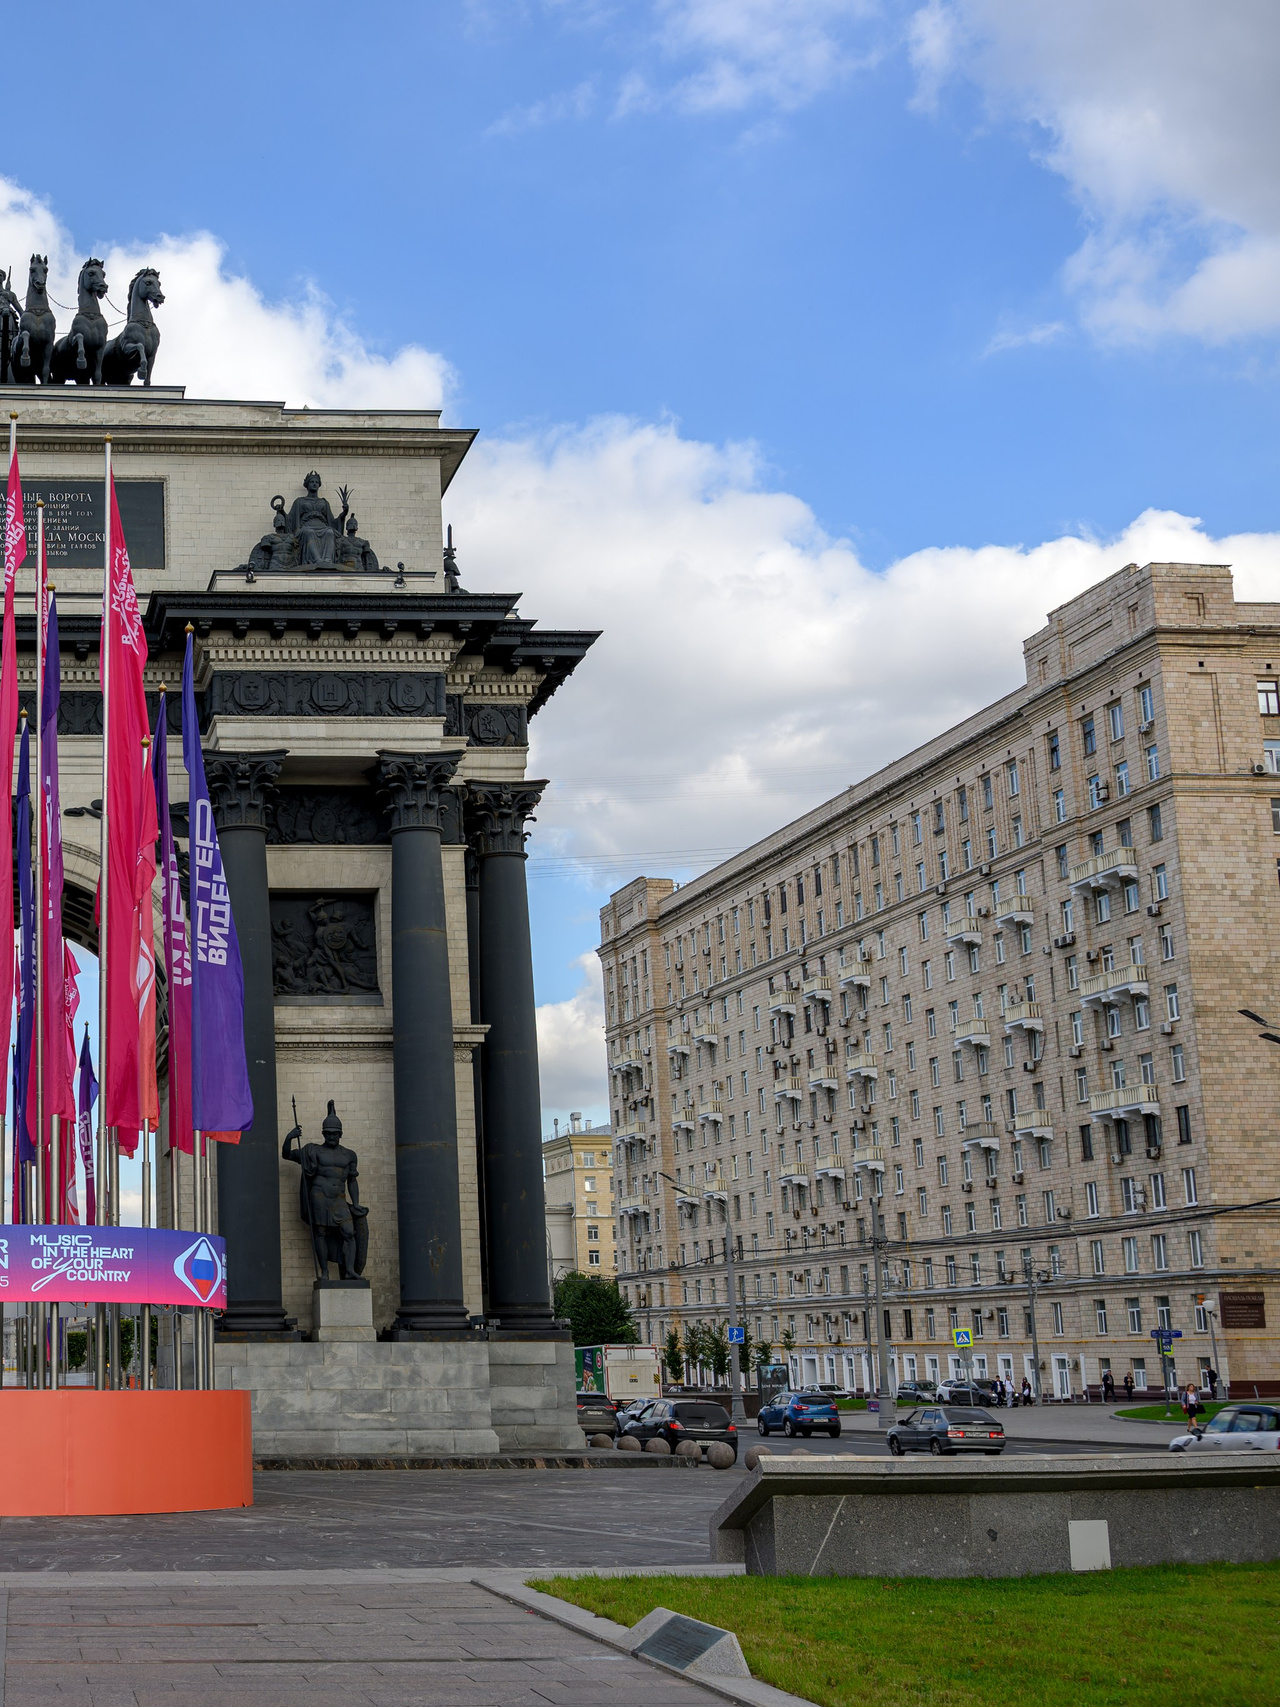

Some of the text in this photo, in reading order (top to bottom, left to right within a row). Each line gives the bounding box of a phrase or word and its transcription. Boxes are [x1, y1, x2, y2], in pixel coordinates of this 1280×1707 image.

[49, 492, 92, 502] ВОРОТА
[68, 532, 106, 542] МОСК
[30, 1234, 93, 1247] MUSIC
[43, 1246, 134, 1259] IN THE HEART
[31, 1257, 53, 1269] OF
[66, 1270, 131, 1282] COUNTRY
